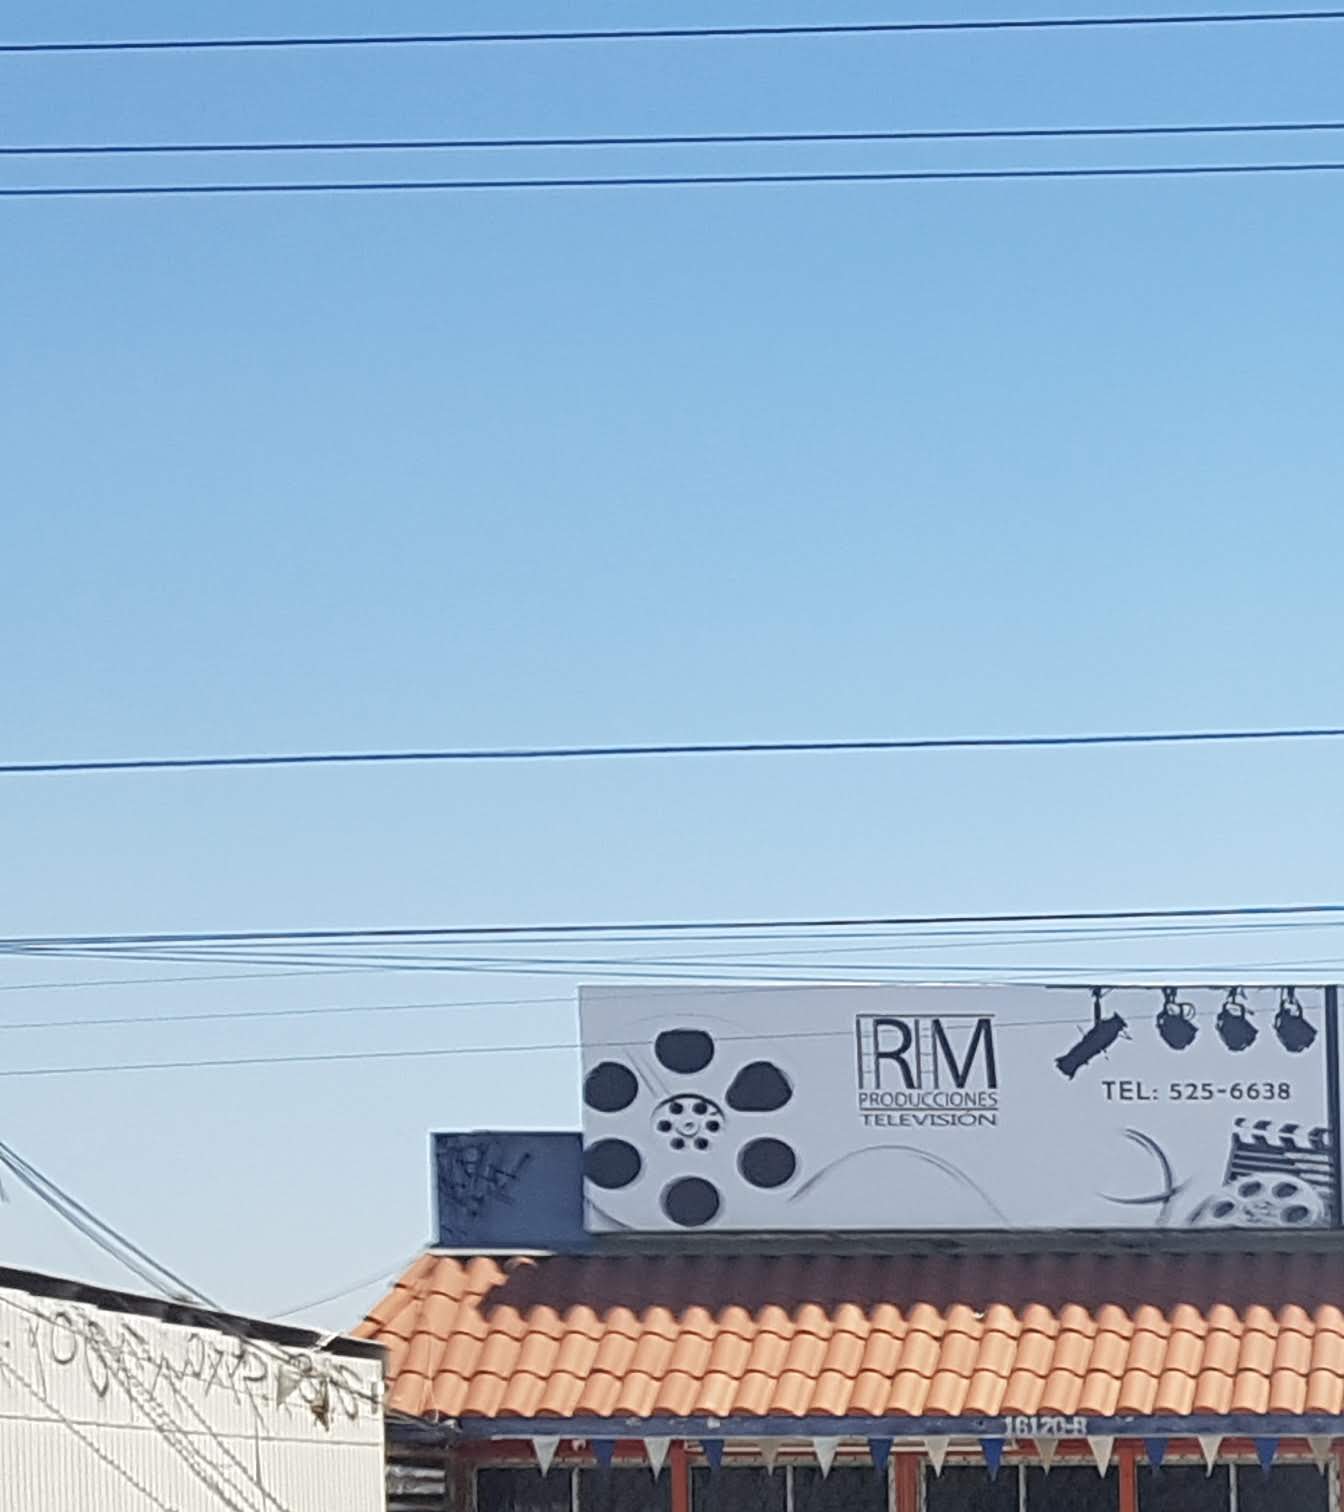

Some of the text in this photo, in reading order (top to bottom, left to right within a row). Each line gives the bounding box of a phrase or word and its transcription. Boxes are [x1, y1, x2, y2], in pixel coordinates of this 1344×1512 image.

[858, 1091, 998, 1107] PRODUCCIONES
[1101, 1080, 1291, 1101] TEL: 525-6638
